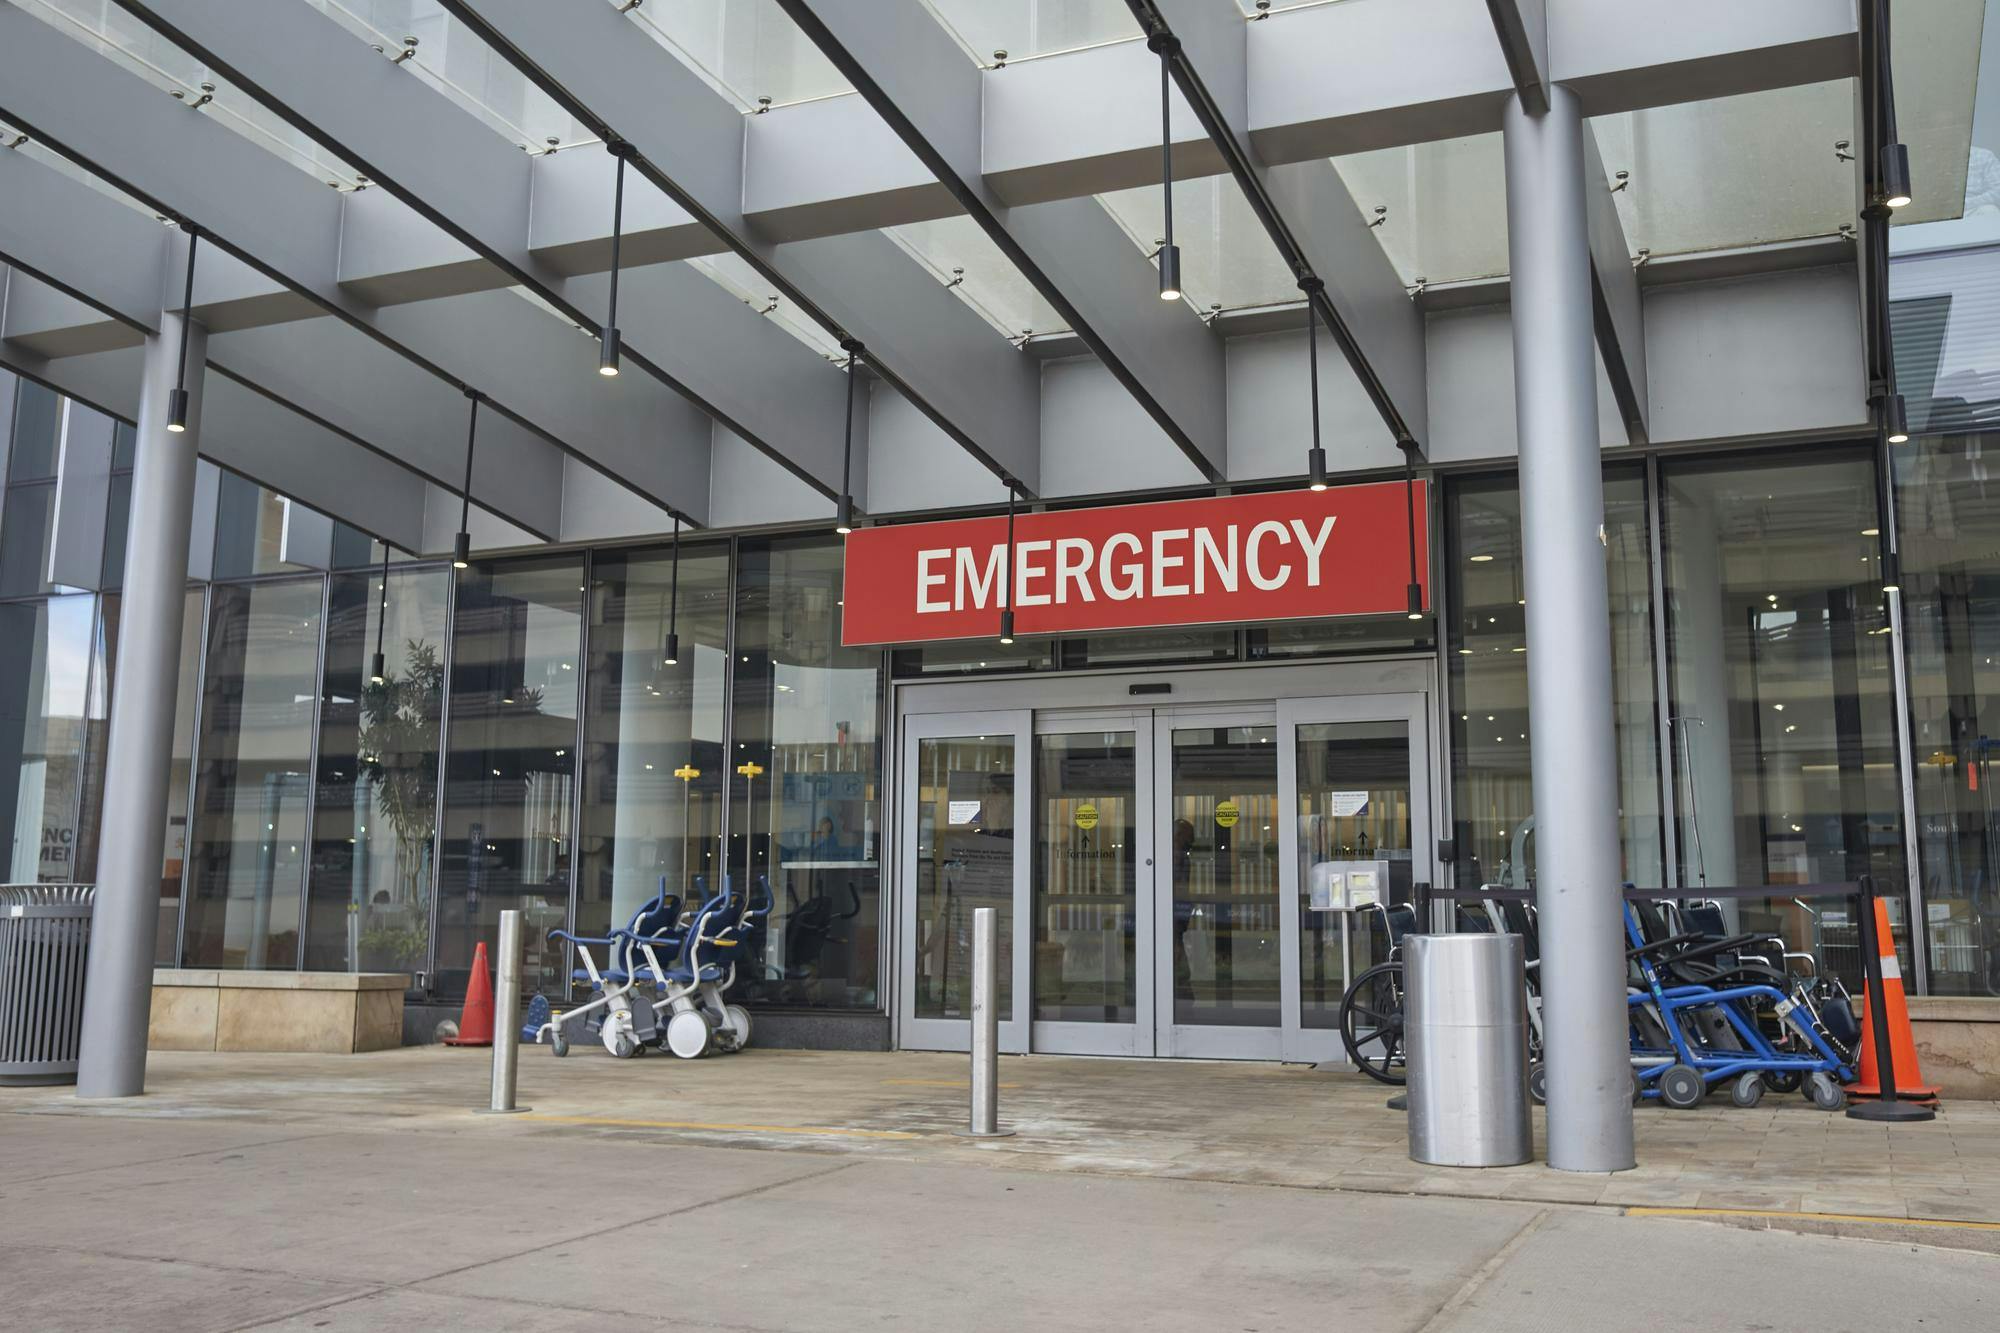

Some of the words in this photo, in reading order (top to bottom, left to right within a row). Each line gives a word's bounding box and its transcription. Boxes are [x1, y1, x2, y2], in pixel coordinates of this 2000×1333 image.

[916, 515, 1337, 614] EMERGENCY
[1926, 823, 1959, 833] Souh
[1330, 847, 1375, 857] Informa
